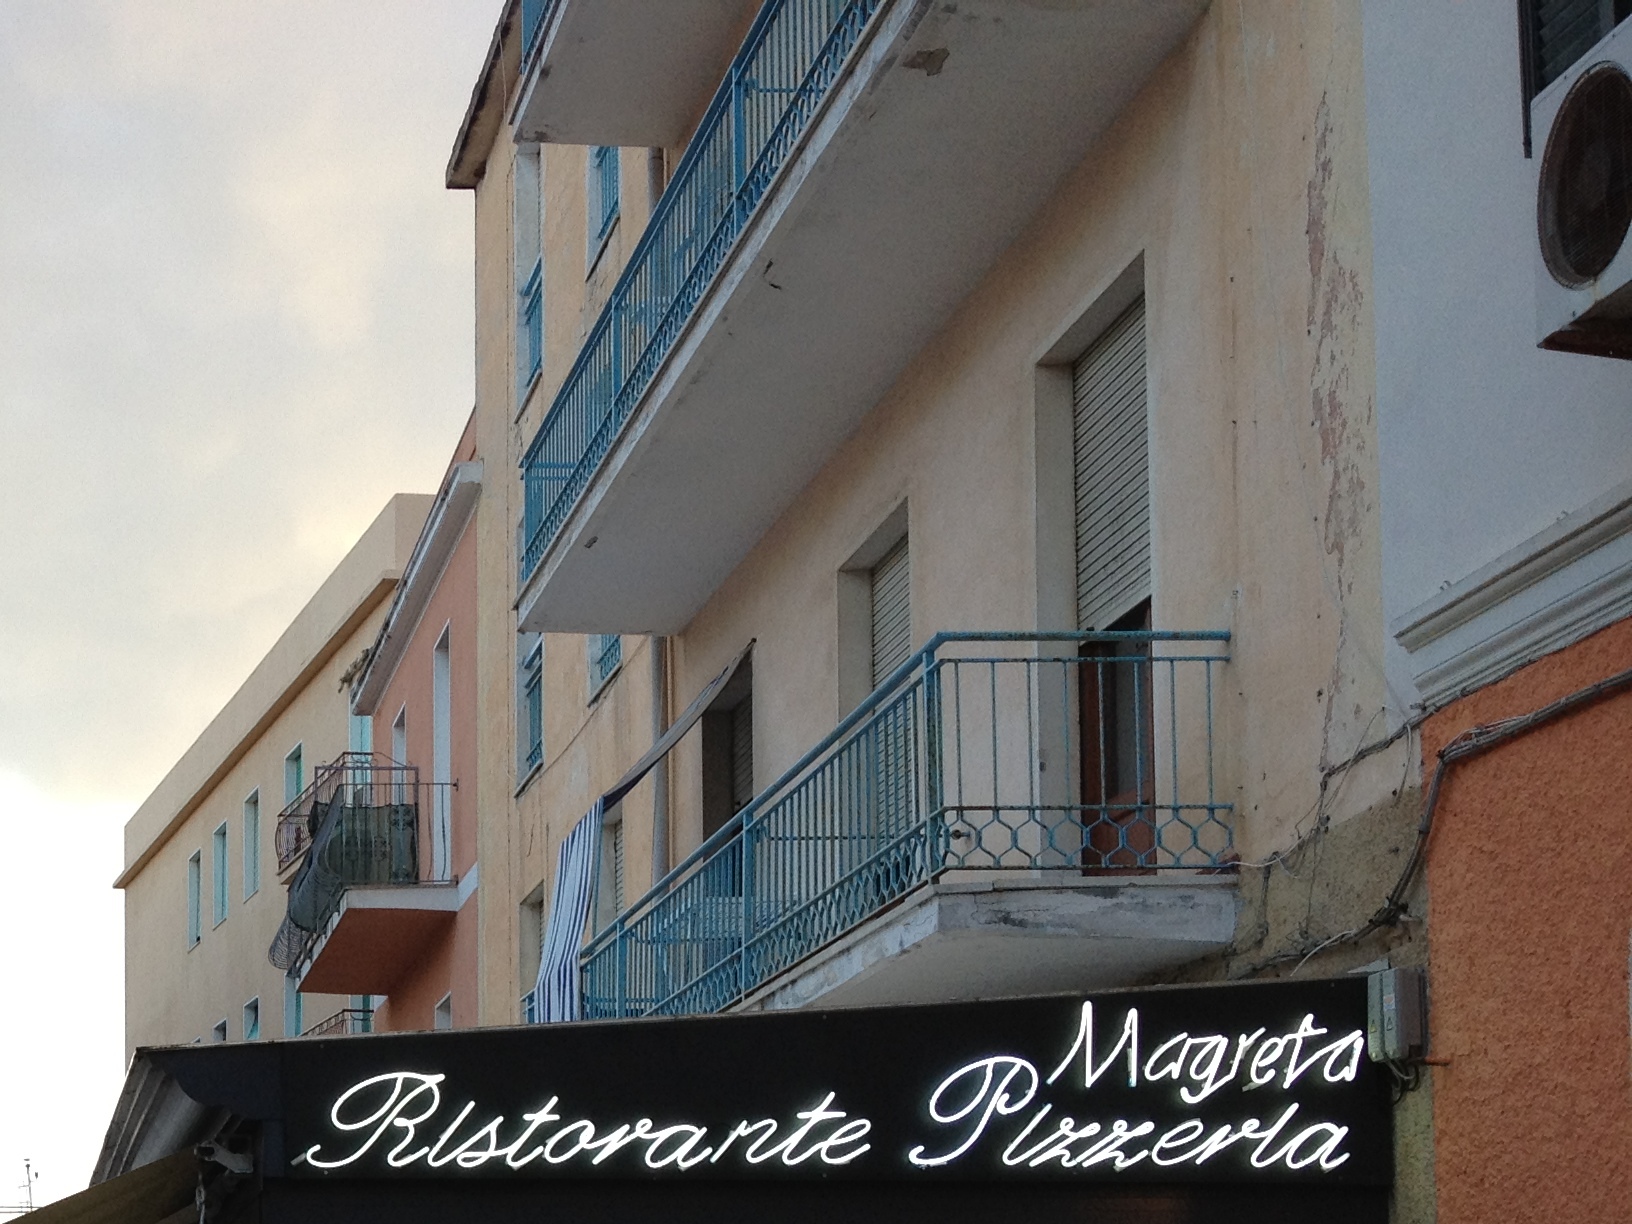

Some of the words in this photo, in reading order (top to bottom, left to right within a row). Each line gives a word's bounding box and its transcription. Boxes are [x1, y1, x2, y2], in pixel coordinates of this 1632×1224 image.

[1048, 999, 1366, 1105] Magreta
[303, 1070, 874, 1170] Ristorante
[908, 1054, 1351, 1172] Pizzeria
